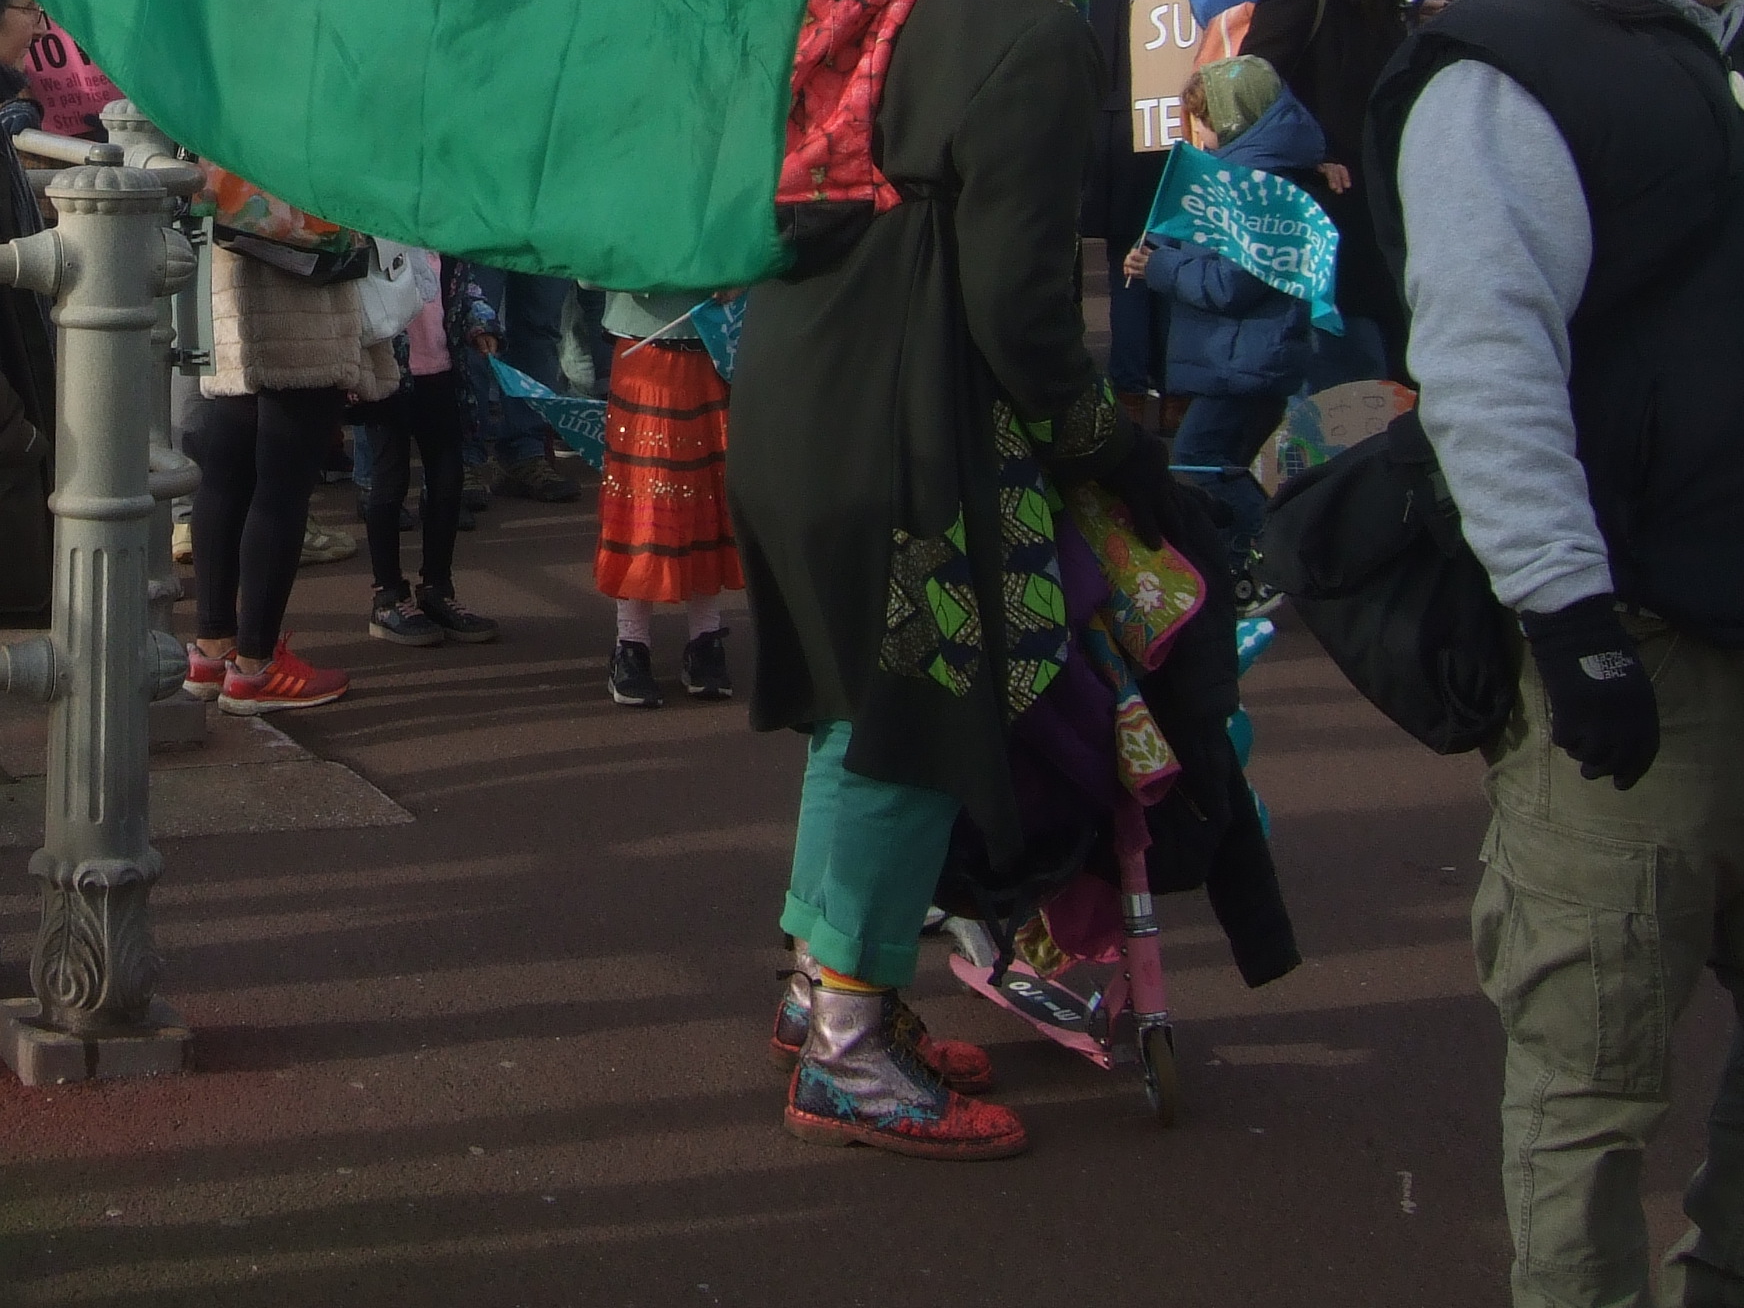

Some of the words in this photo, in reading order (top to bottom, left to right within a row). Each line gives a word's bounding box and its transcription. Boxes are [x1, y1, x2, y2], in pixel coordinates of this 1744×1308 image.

[1144, 3, 1197, 51] SU
[29, 33, 67, 72] TO
[40, 78, 62, 92] We
[66, 72, 83, 89] all
[85, 75, 112, 88] nee
[59, 92, 83, 109] pay
[1135, 96, 1182, 148] TE
[1233, 206, 1328, 259] national
[558, 413, 606, 445] unio
[1605, 668, 1627, 679] THE
